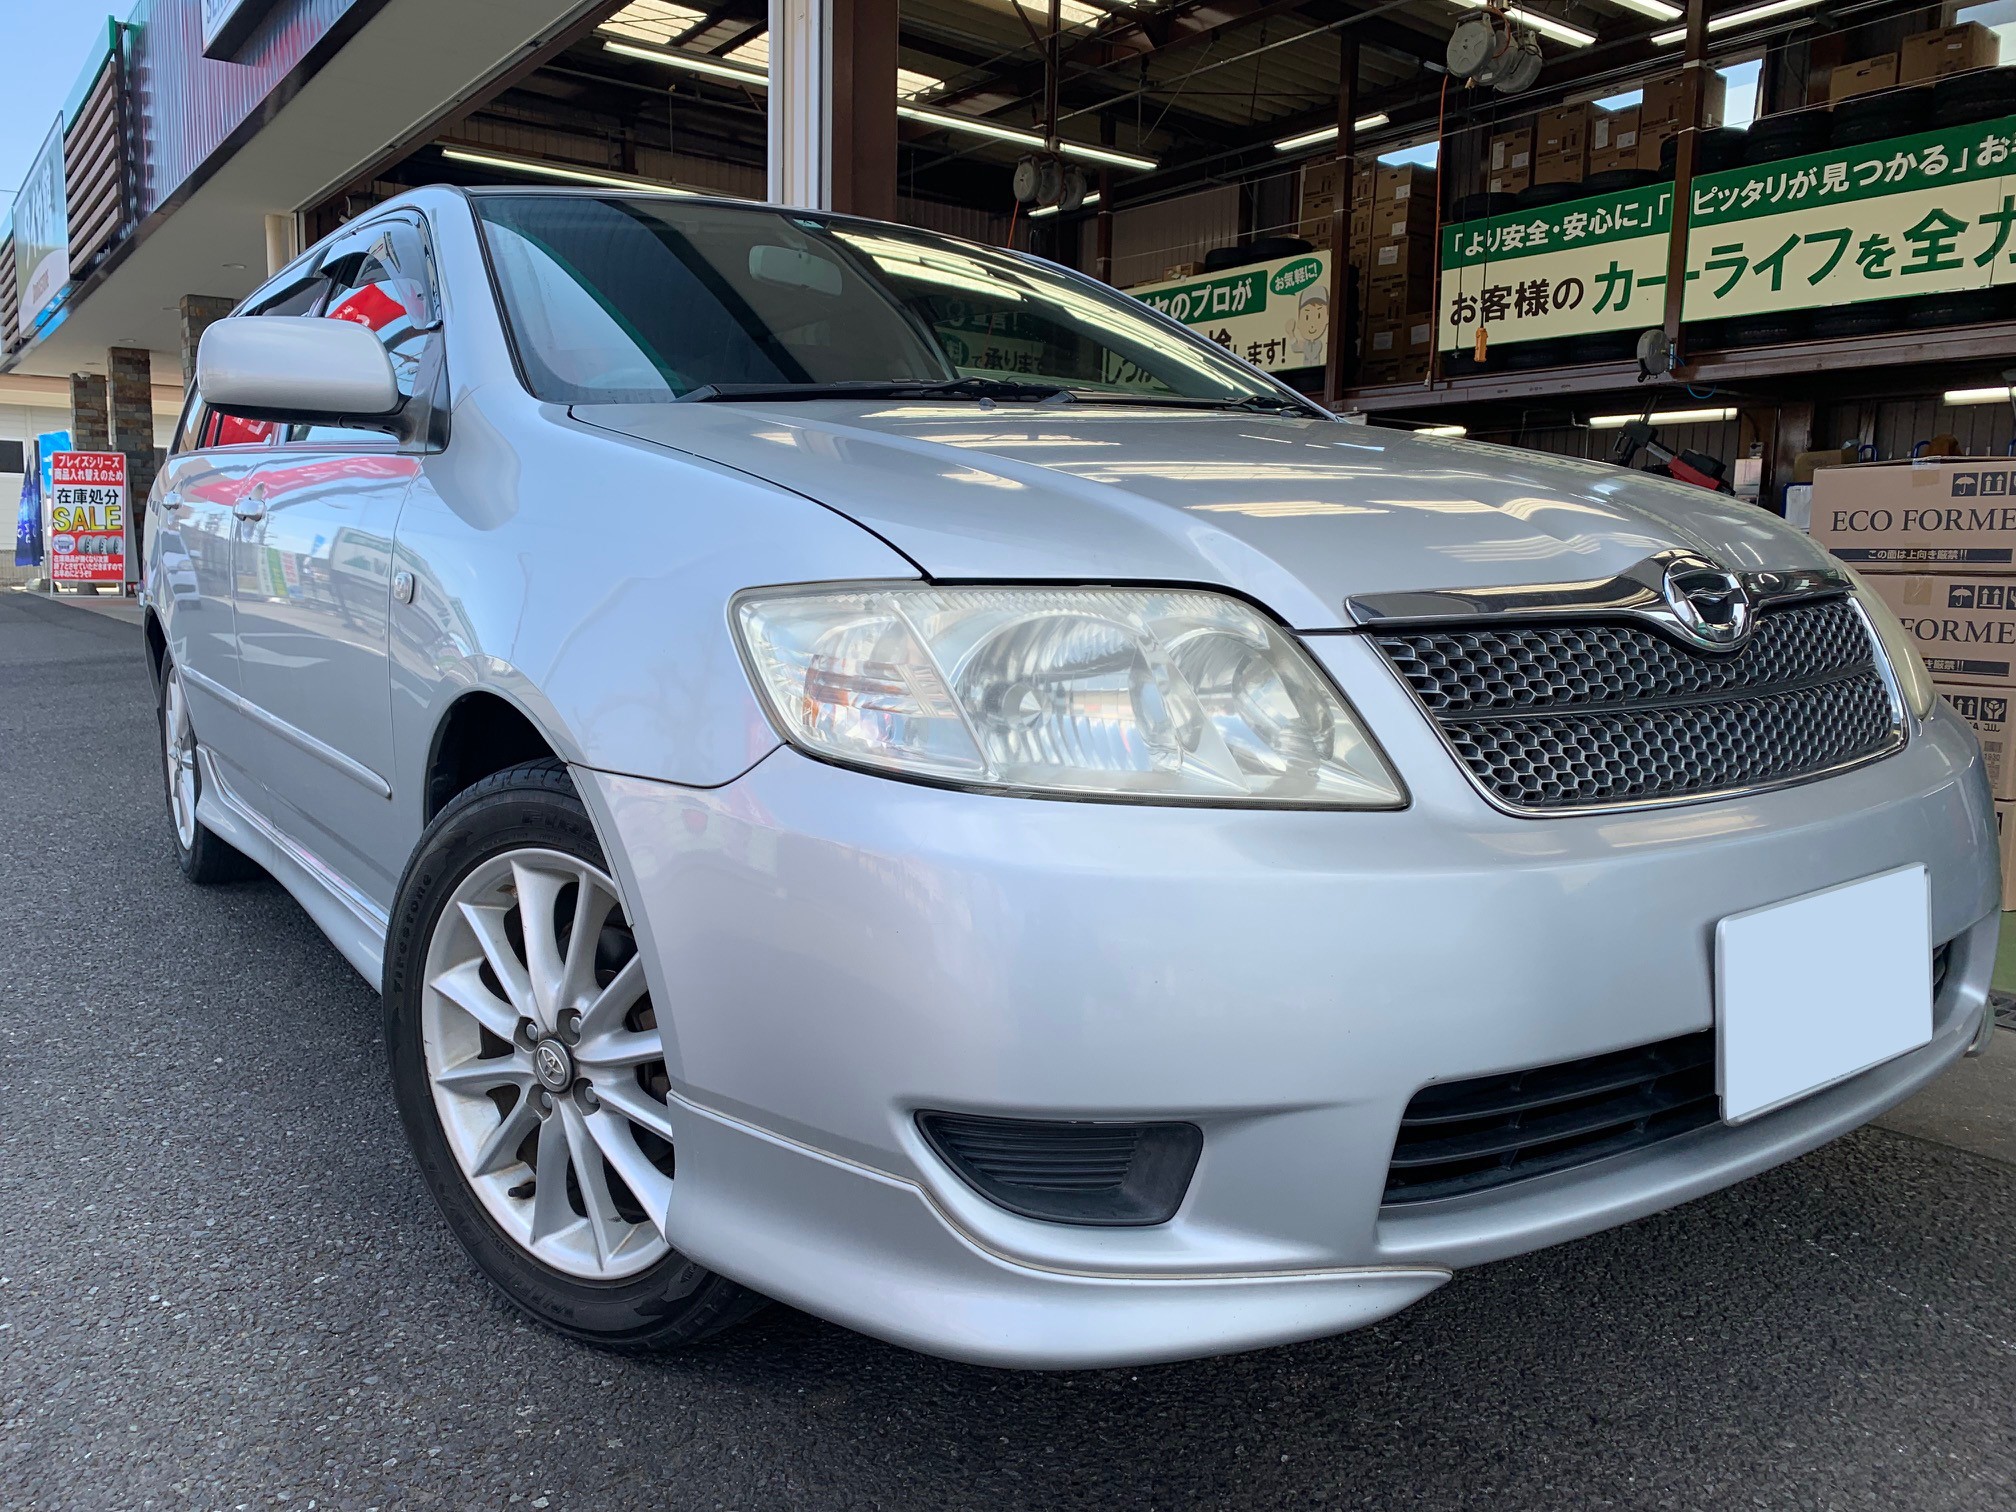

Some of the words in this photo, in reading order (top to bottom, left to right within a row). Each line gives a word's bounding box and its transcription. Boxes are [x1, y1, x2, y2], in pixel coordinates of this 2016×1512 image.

[57, 488, 119, 504] 在庫処分
[53, 505, 123, 532] SALE
[1830, 509, 1893, 532] ECO
